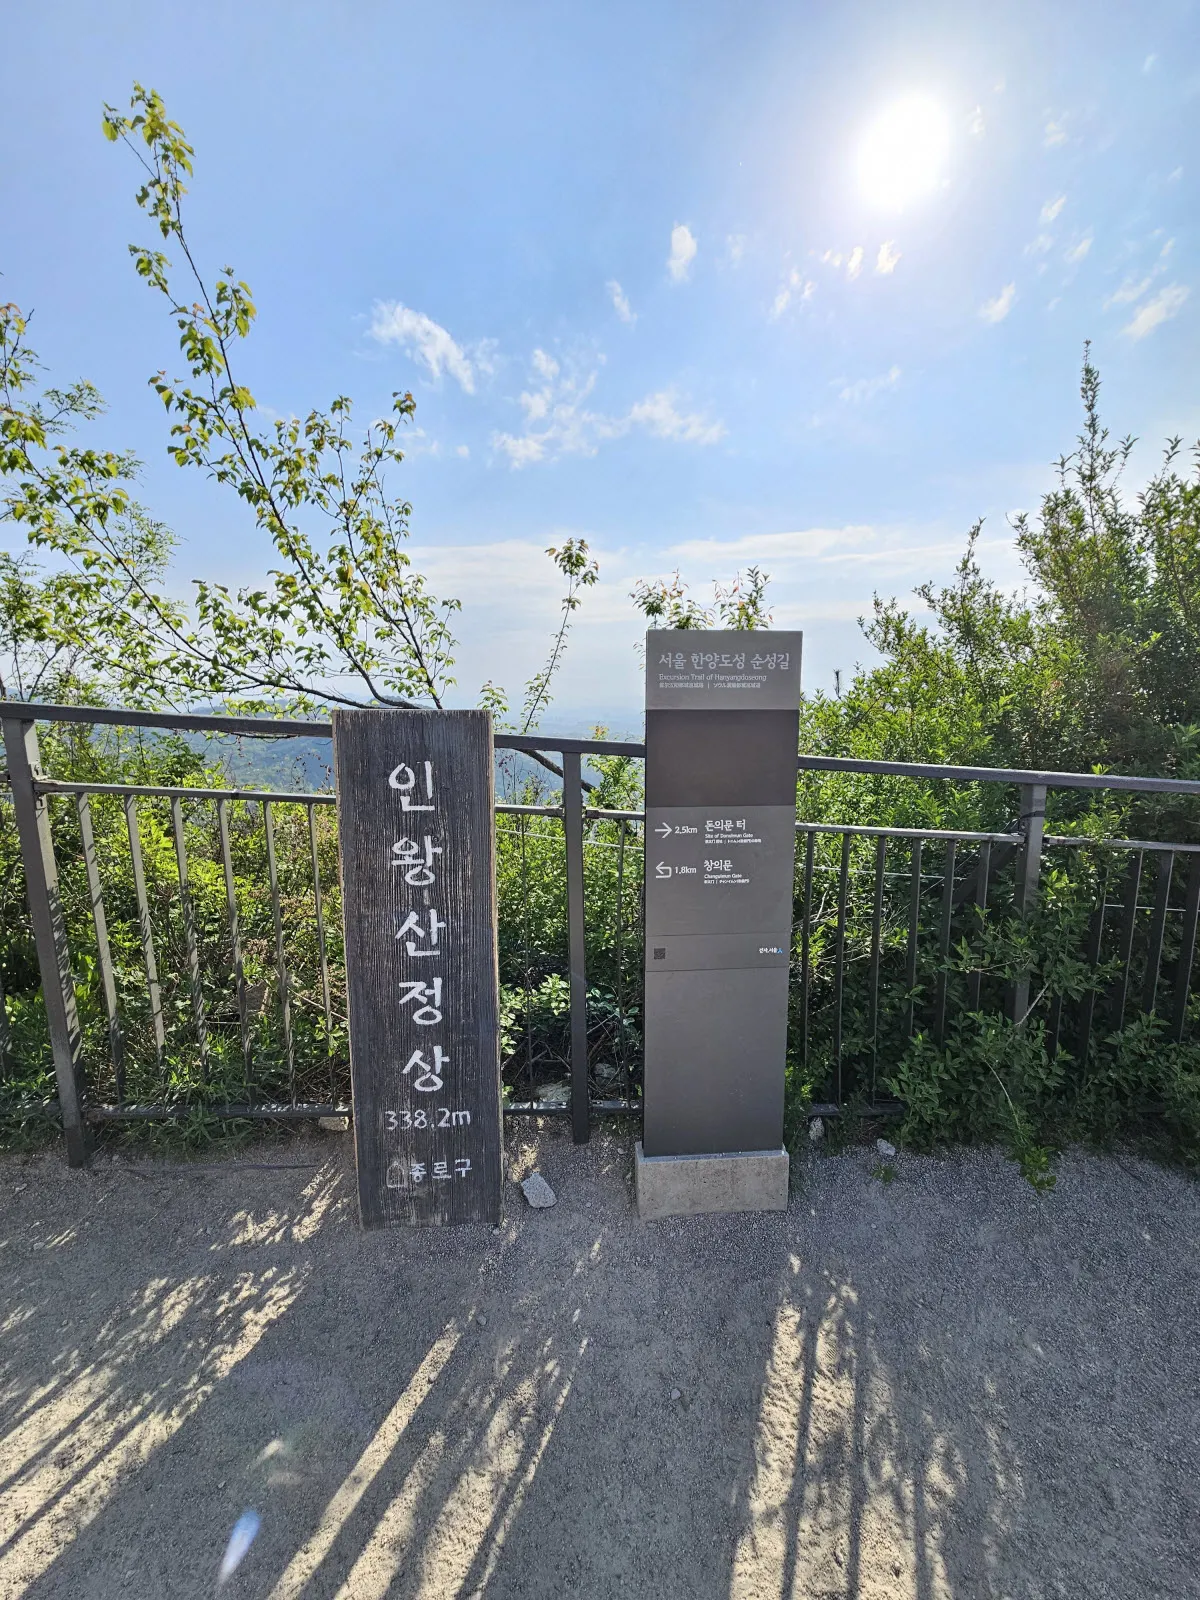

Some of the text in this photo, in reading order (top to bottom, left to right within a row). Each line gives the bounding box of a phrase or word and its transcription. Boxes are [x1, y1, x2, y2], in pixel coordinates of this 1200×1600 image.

[659, 652, 790, 670] 서울 한양도성 순성길
[659, 673, 690, 681] Excursion
[714, 673, 767, 682] Hanyangdoseong
[674, 826, 698, 834] 2.5km
[704, 819, 746, 831] 돈의문 터
[674, 866, 697, 874] 1.8km
[703, 860, 733, 872] 창의문
[388, 760, 450, 1092] 인왕산정상
[385, 1108, 471, 1130] 338.2m
[409, 1158, 473, 1183] 종로구
